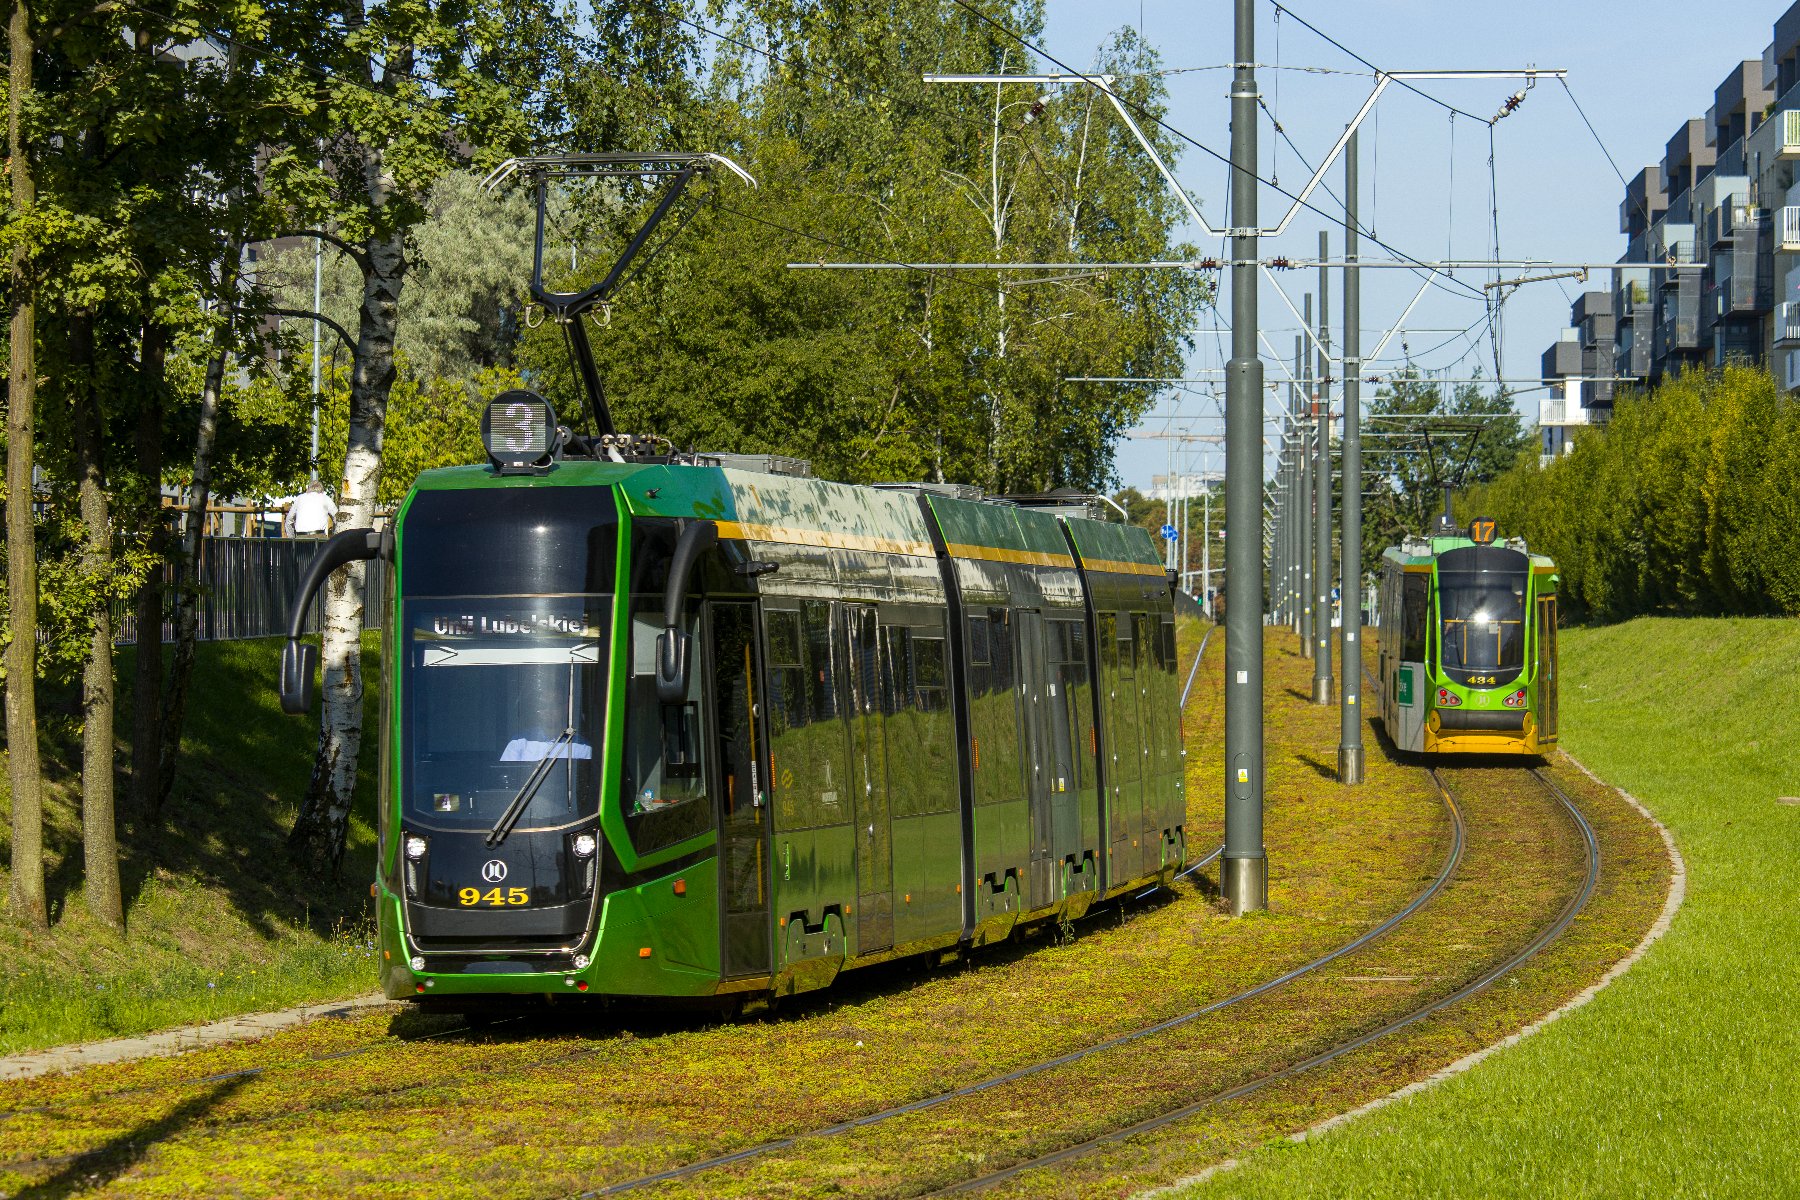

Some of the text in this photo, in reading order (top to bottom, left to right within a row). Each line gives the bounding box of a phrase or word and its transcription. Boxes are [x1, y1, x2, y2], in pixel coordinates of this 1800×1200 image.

[505, 403, 533, 452] 3
[1472, 521, 1495, 542] 17
[434, 614, 589, 636] Unii Lubelskiej
[1467, 675, 1496, 685] 434
[458, 887, 529, 906] 945
